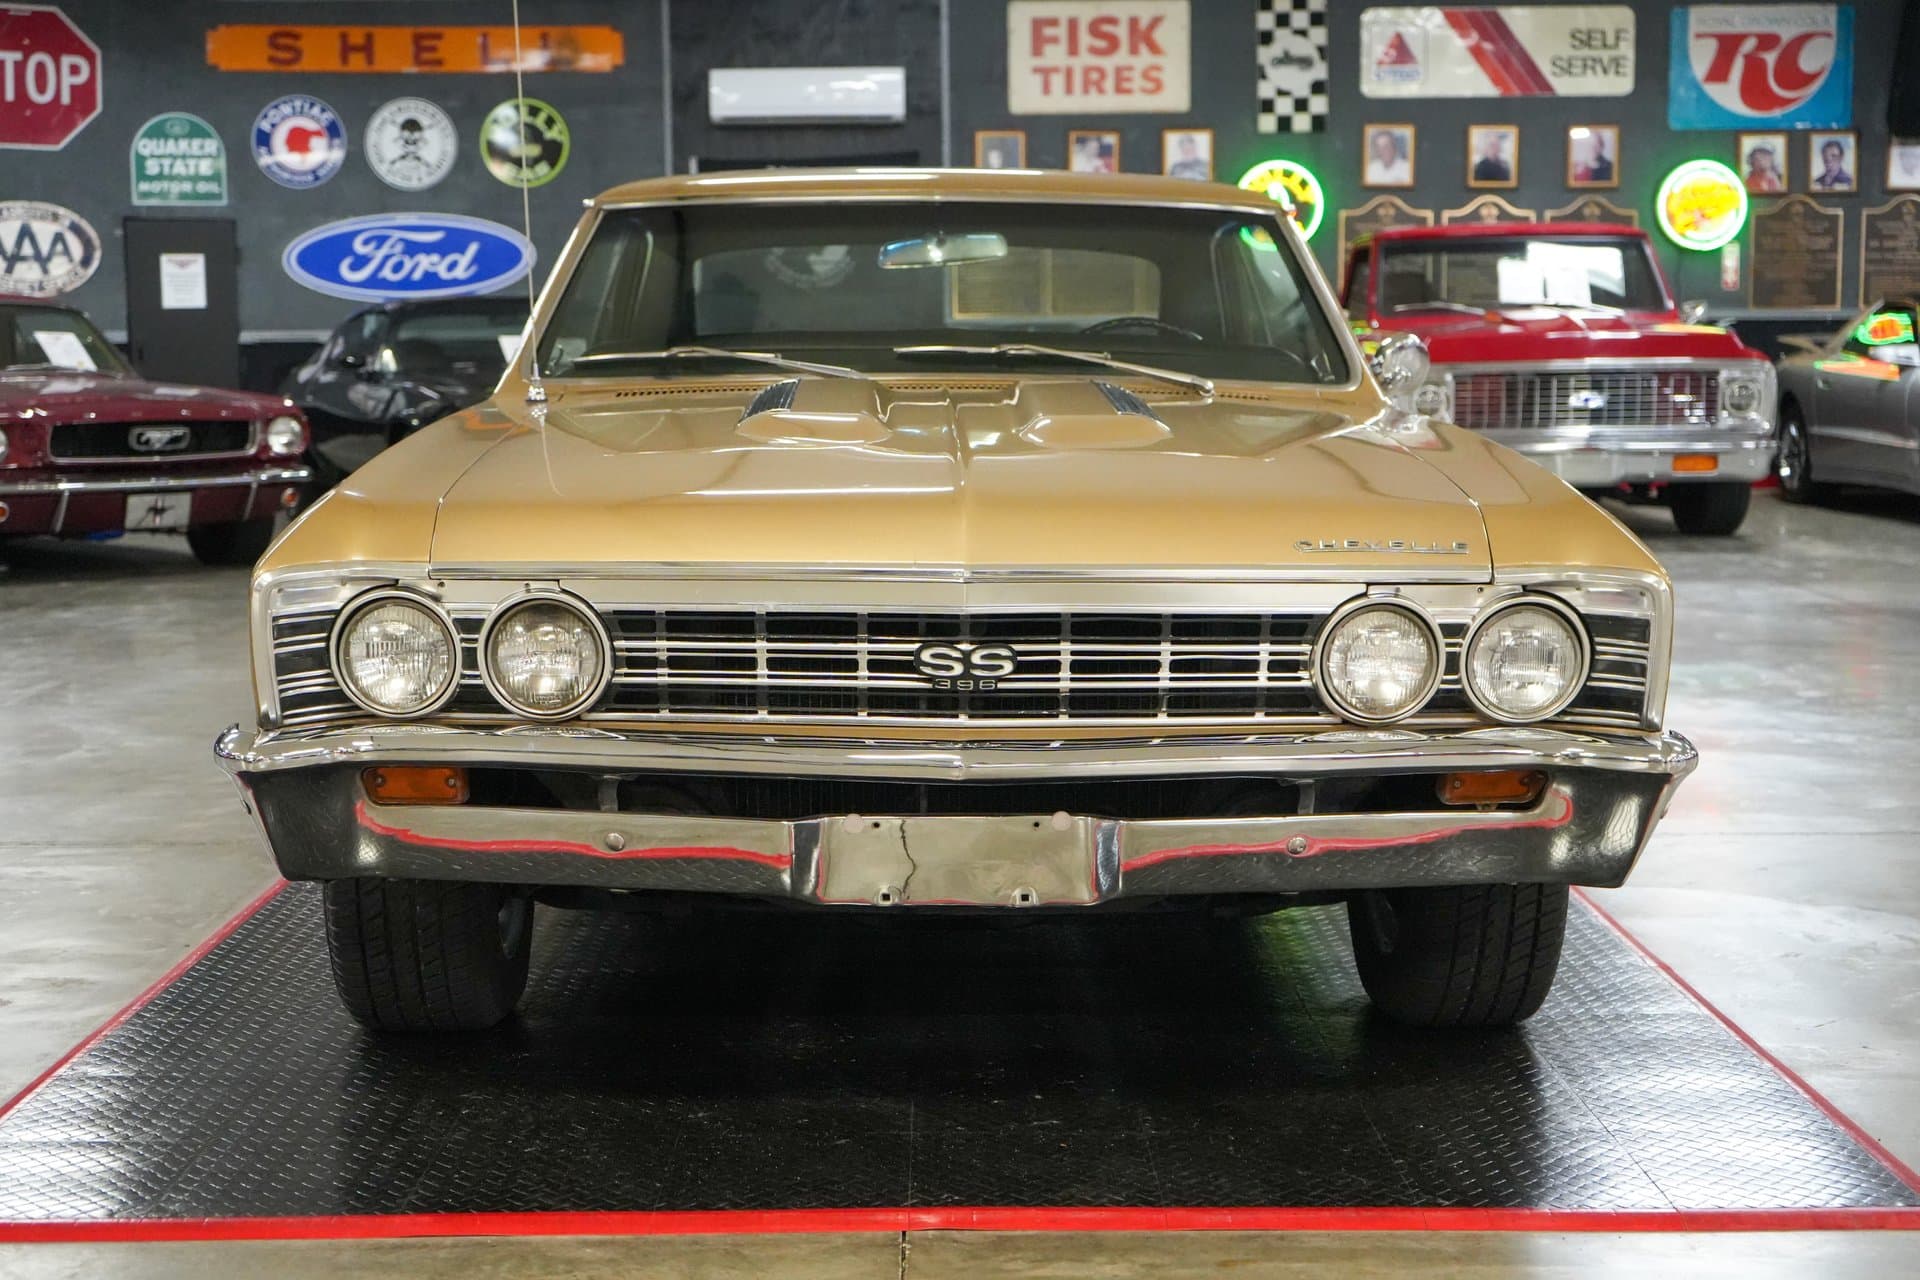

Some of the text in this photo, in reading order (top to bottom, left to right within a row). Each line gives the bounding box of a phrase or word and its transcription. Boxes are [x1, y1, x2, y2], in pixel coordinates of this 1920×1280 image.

[1030, 15, 1166, 57] FISK
[1569, 28, 1630, 50] SELF
[1551, 56, 1629, 78] SERVE
[1694, 32, 1834, 112] RC
[1032, 65, 1165, 96] TIRES
[260, 99, 337, 133] PONTIAC
[487, 104, 563, 140] OLLY
[137, 137, 218, 158] QUAKER
[144, 157, 215, 177] STATE
[138, 181, 220, 194] MOTOR OIL
[339, 228, 478, 283] Ford
[1294, 539, 1468, 553] CHEVELLE
[919, 645, 1014, 677] SS
[934, 678, 996, 691] 396
